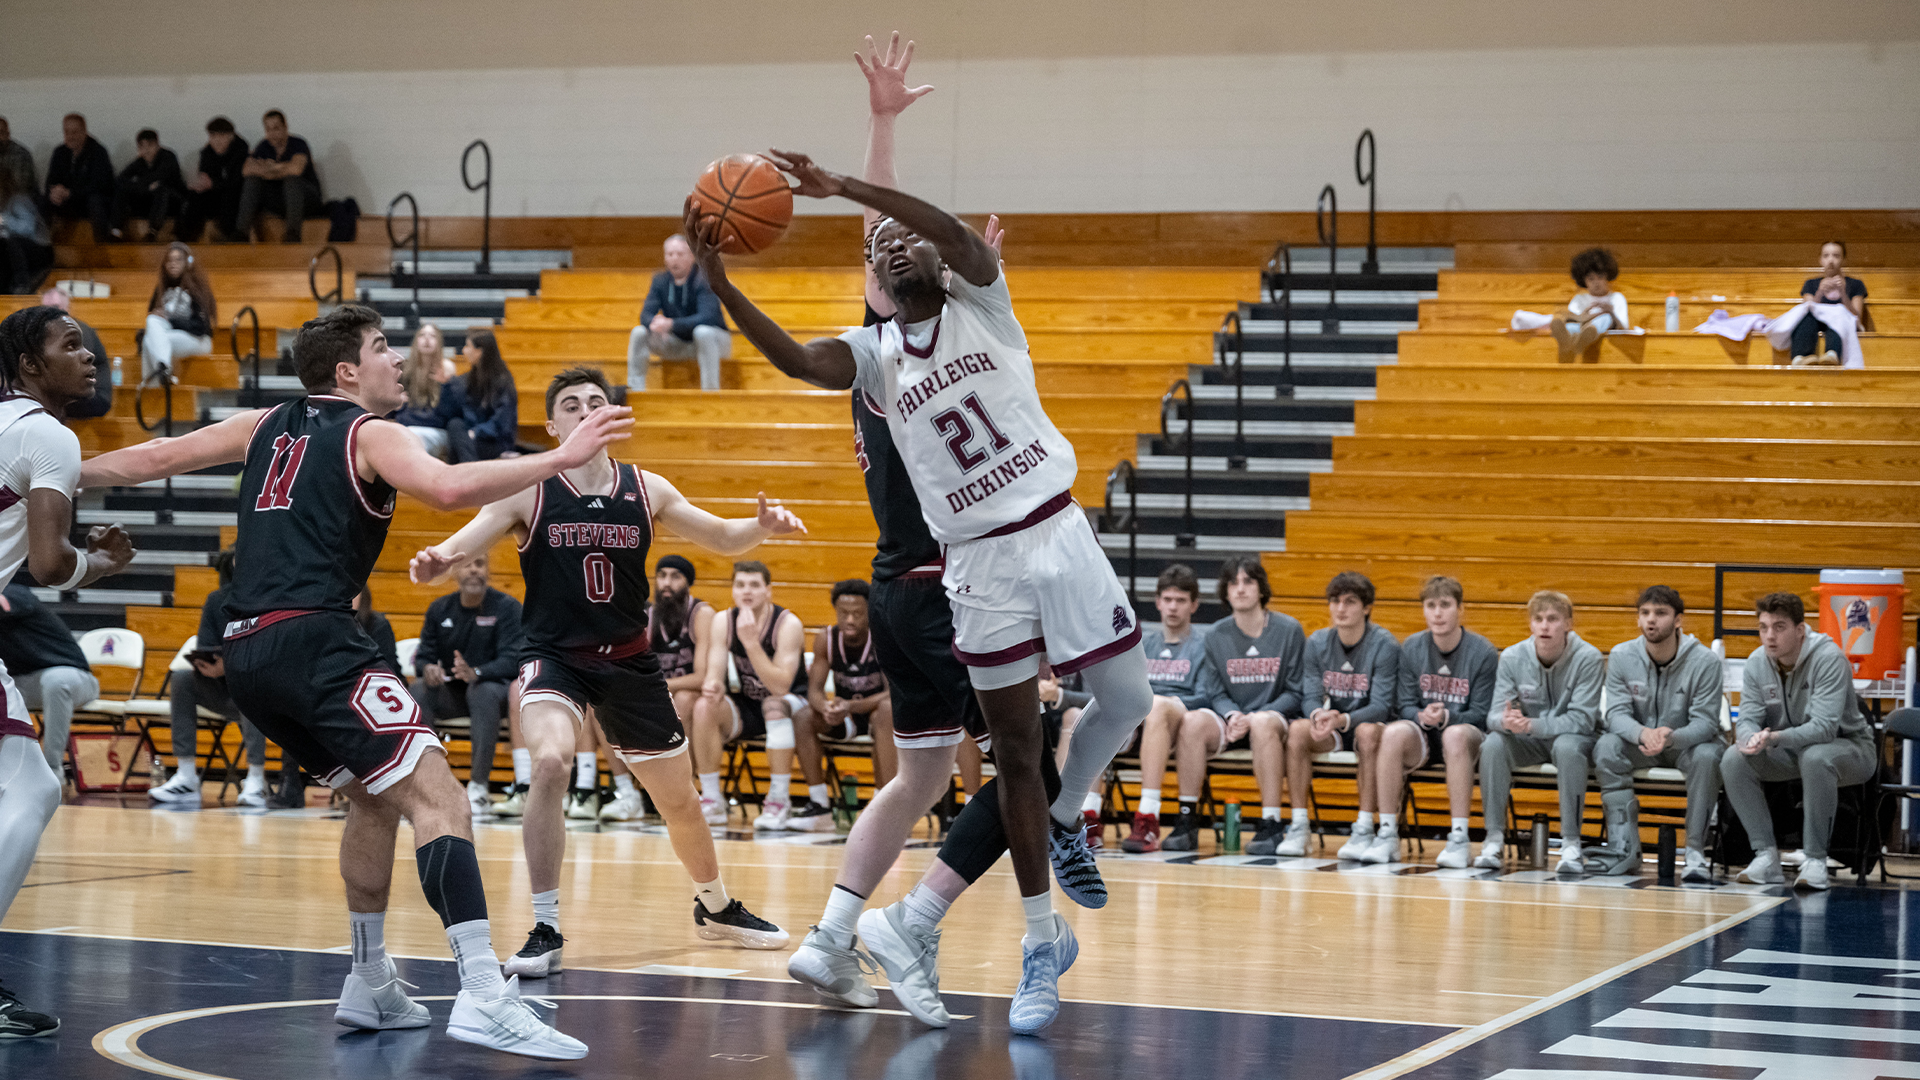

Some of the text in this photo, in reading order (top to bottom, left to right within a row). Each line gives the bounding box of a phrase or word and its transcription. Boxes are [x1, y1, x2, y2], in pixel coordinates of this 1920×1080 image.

[896, 352, 998, 424] FAIRLEIGH
[930, 391, 1014, 475] 21
[254, 431, 311, 512] 11
[946, 439, 1049, 514] DICKINSON
[548, 523, 640, 549] STEVENS
[583, 553, 614, 603] 0
[376, 685, 404, 713] S
[107, 750, 122, 773] S
